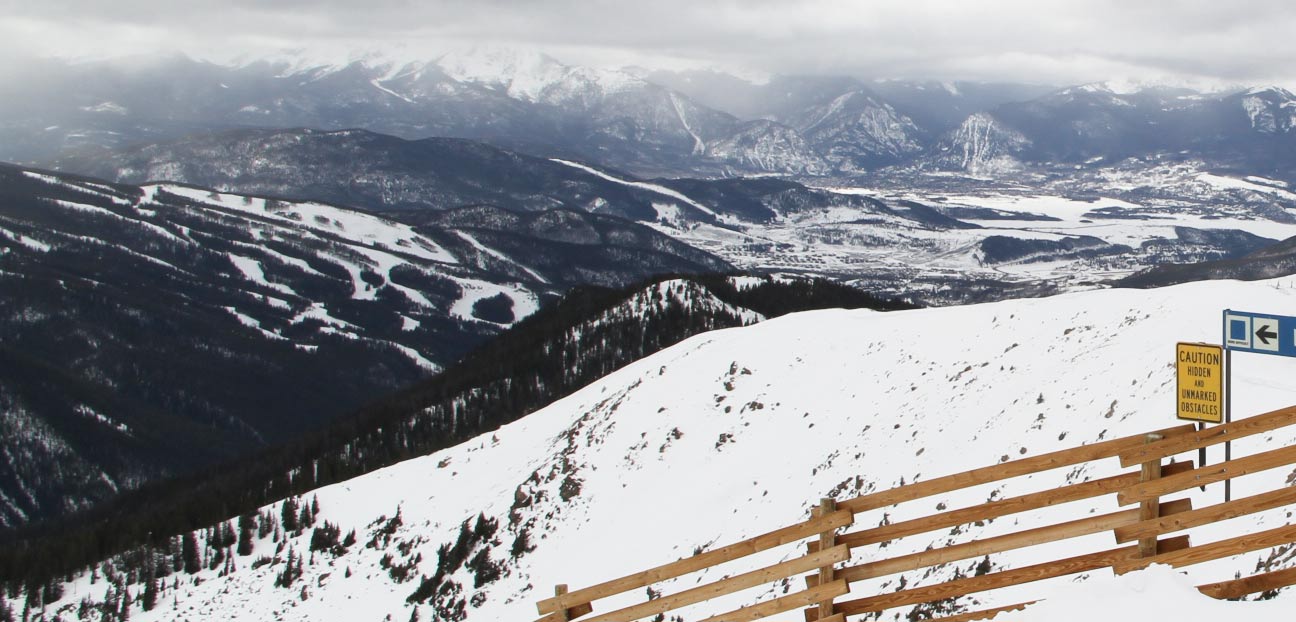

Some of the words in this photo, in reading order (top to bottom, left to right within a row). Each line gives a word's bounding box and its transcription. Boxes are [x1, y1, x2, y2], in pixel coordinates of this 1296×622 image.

[1180, 350, 1219, 365] CAUTION
[1187, 366, 1211, 378] HIDDEN
[1182, 389, 1217, 402] UNMARKED
[1181, 402, 1217, 415] OBSTACLES
